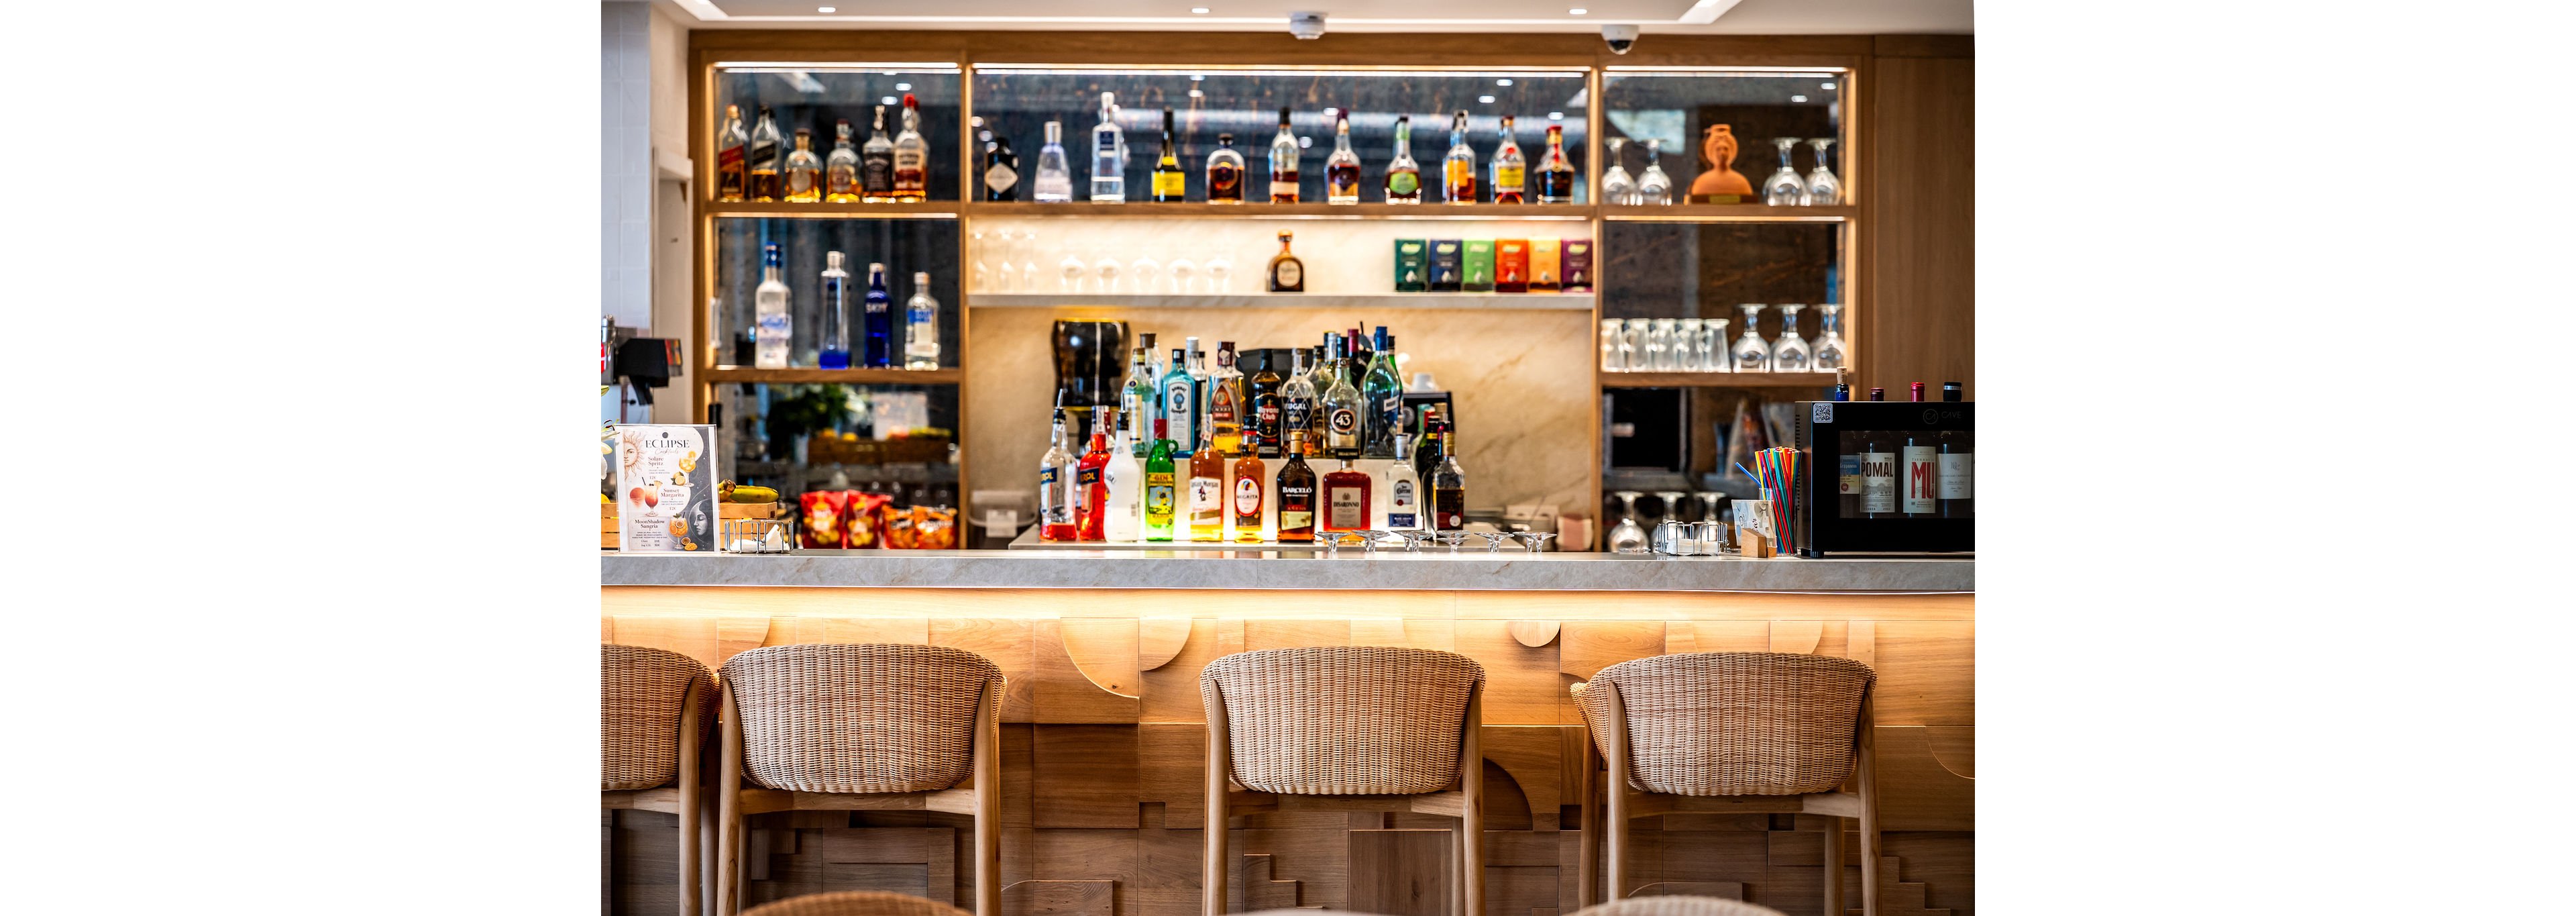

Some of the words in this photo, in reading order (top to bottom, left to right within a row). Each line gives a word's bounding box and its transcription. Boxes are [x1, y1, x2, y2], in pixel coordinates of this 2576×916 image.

[1335, 414, 1351, 426] 43
[645, 440, 690, 448] ECLIPSE
[1861, 462, 1894, 477] POMAL
[1041, 472, 1054, 481] ROL
